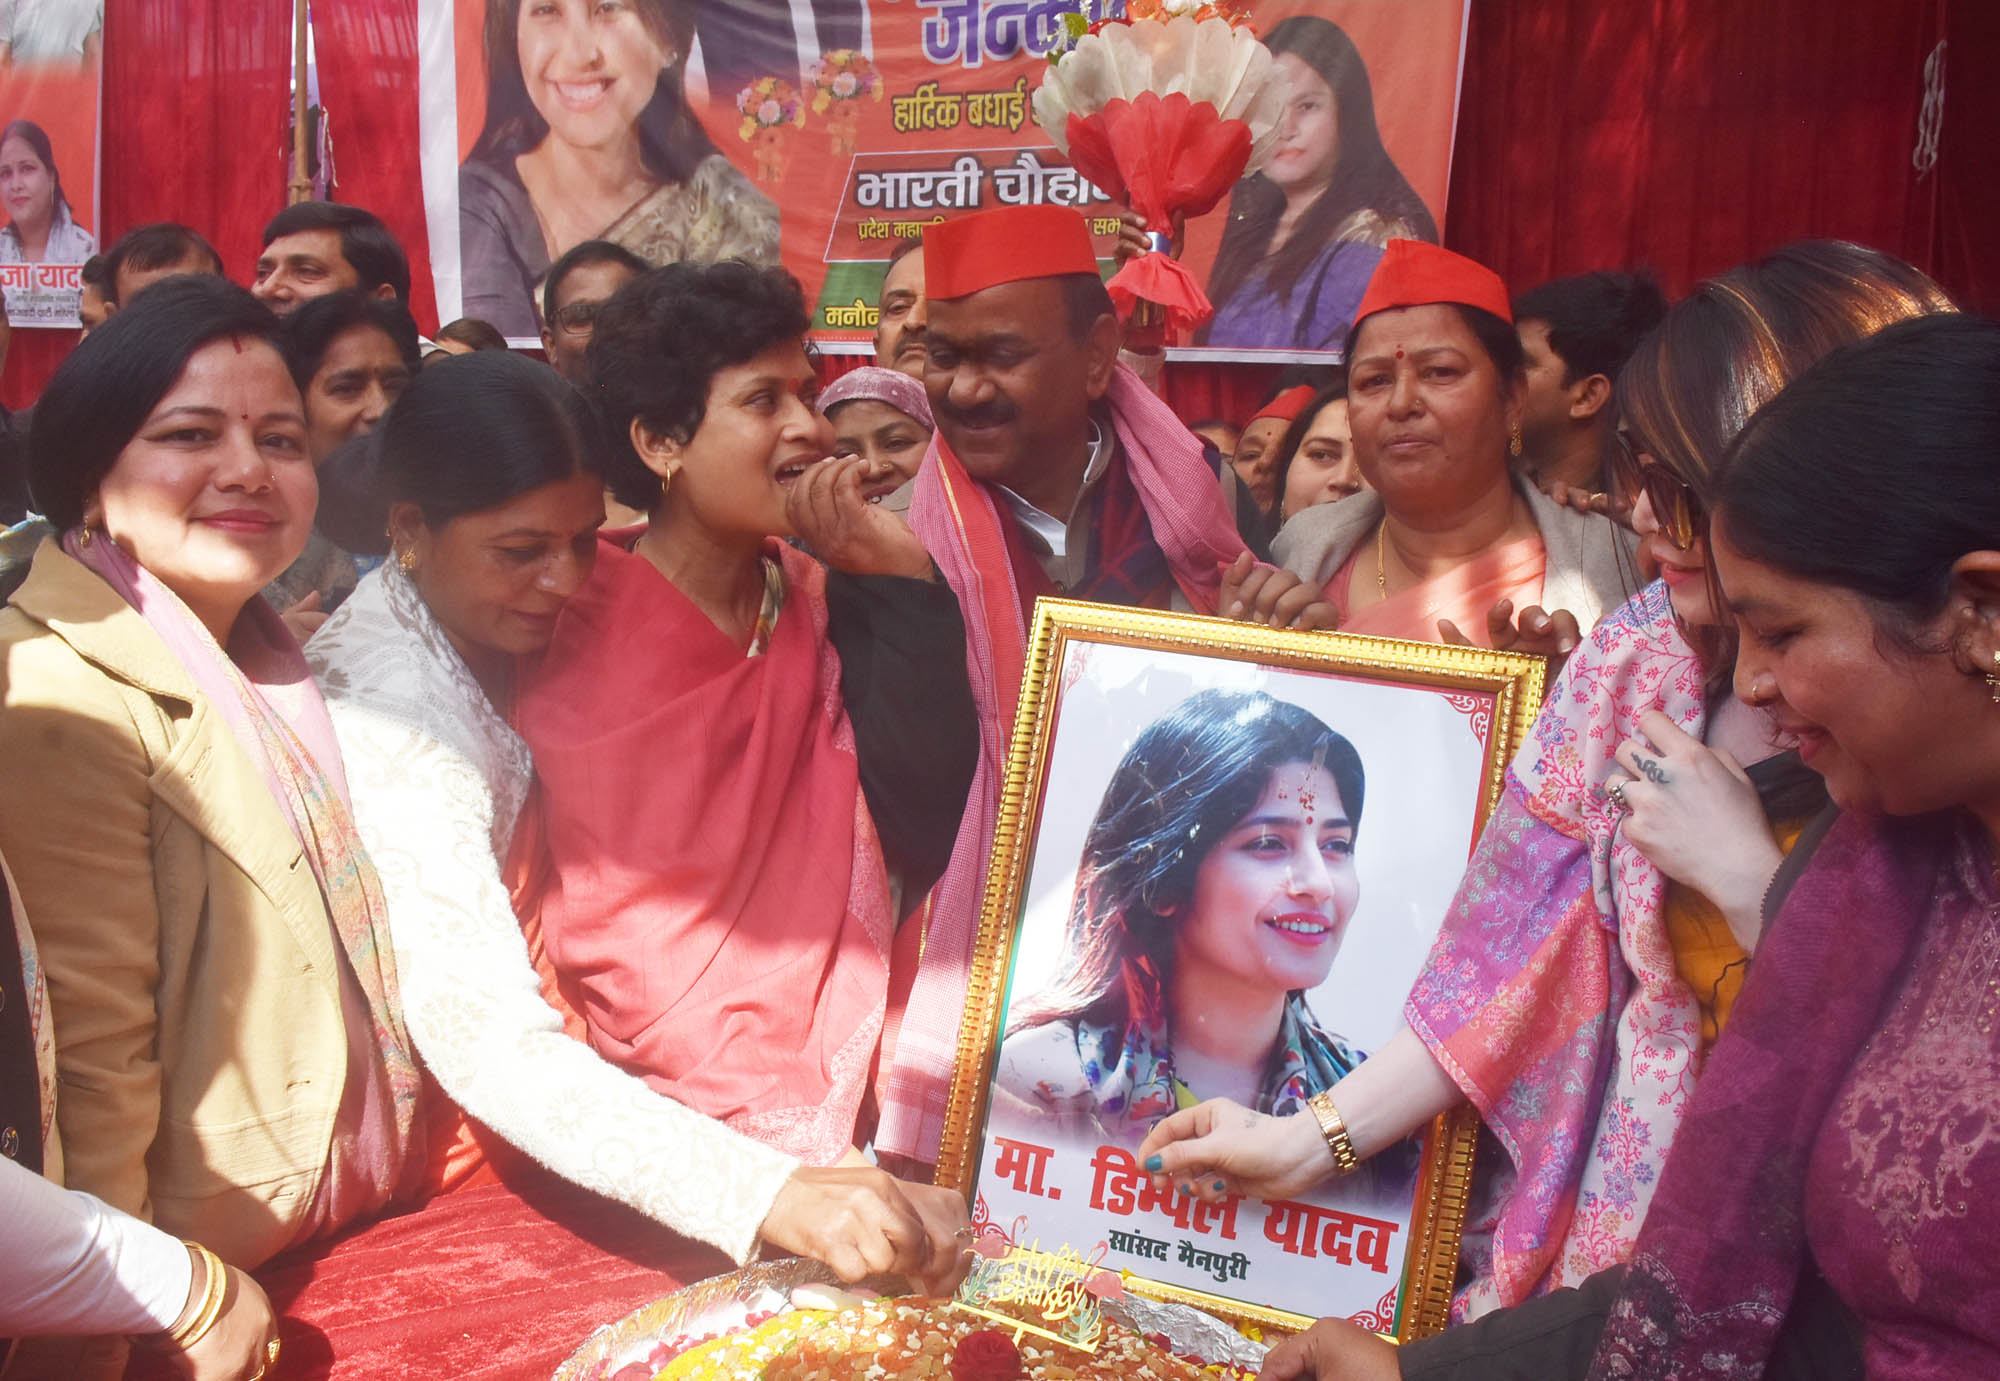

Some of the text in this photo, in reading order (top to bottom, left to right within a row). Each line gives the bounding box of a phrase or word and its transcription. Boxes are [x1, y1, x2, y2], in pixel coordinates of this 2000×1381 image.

[892, 83, 962, 131] हार्दिक
[966, 77, 1026, 131] बधाई
[857, 156, 984, 208] भारती
[858, 216, 889, 239] प्रदेश
[994, 1136, 1062, 1201] मा.
[1262, 1199, 1400, 1274] यादव
[1108, 1228, 1252, 1283] सांसद मैनपुरी
